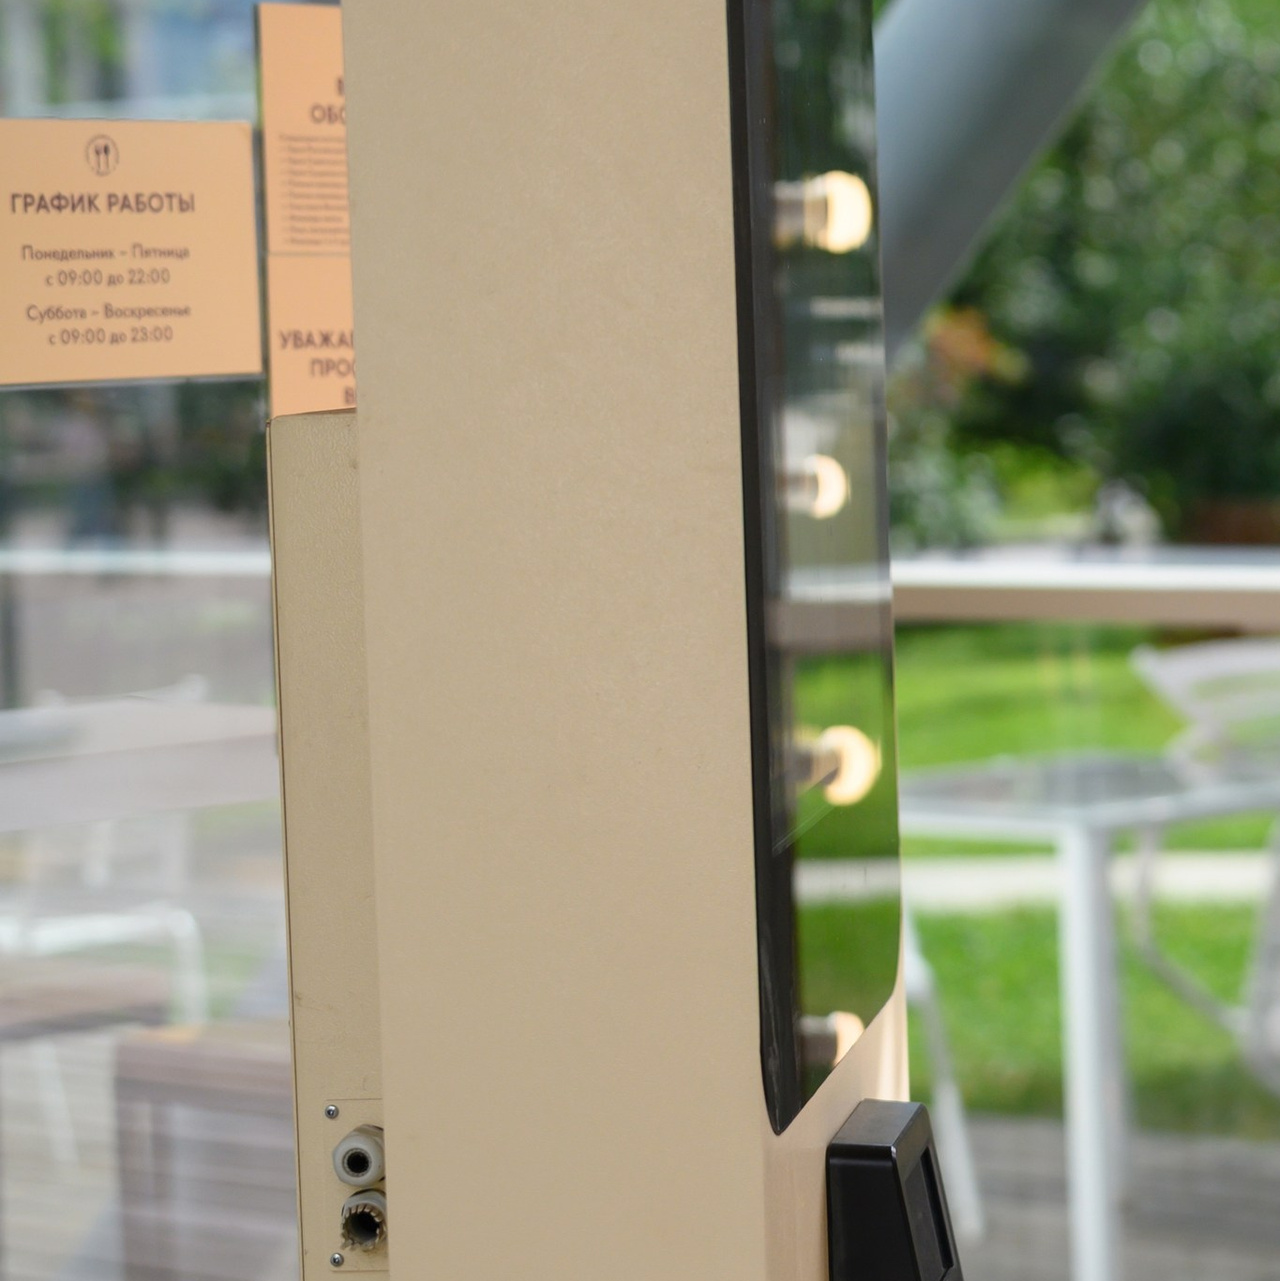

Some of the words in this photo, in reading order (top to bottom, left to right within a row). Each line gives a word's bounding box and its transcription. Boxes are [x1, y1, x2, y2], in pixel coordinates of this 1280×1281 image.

[11, 193, 101, 213] ГРАФИК
[107, 192, 195, 213] РАБОТЫ
[22, 245, 115, 261] Понедельник
[132, 243, 189, 260] Пятница
[46, 276, 53, 287] с
[57, 269, 103, 286] 09:00
[107, 274, 124, 286] до
[128, 268, 170, 285] 22:00
[26, 304, 87, 323] Суббота
[104, 303, 192, 320] Воскресенье
[49, 334, 56, 345] с
[60, 328, 105, 345] 09:00
[110, 332, 127, 345] до
[131, 326, 173, 342] 23:00
[311, 358, 356, 378] ПРО
